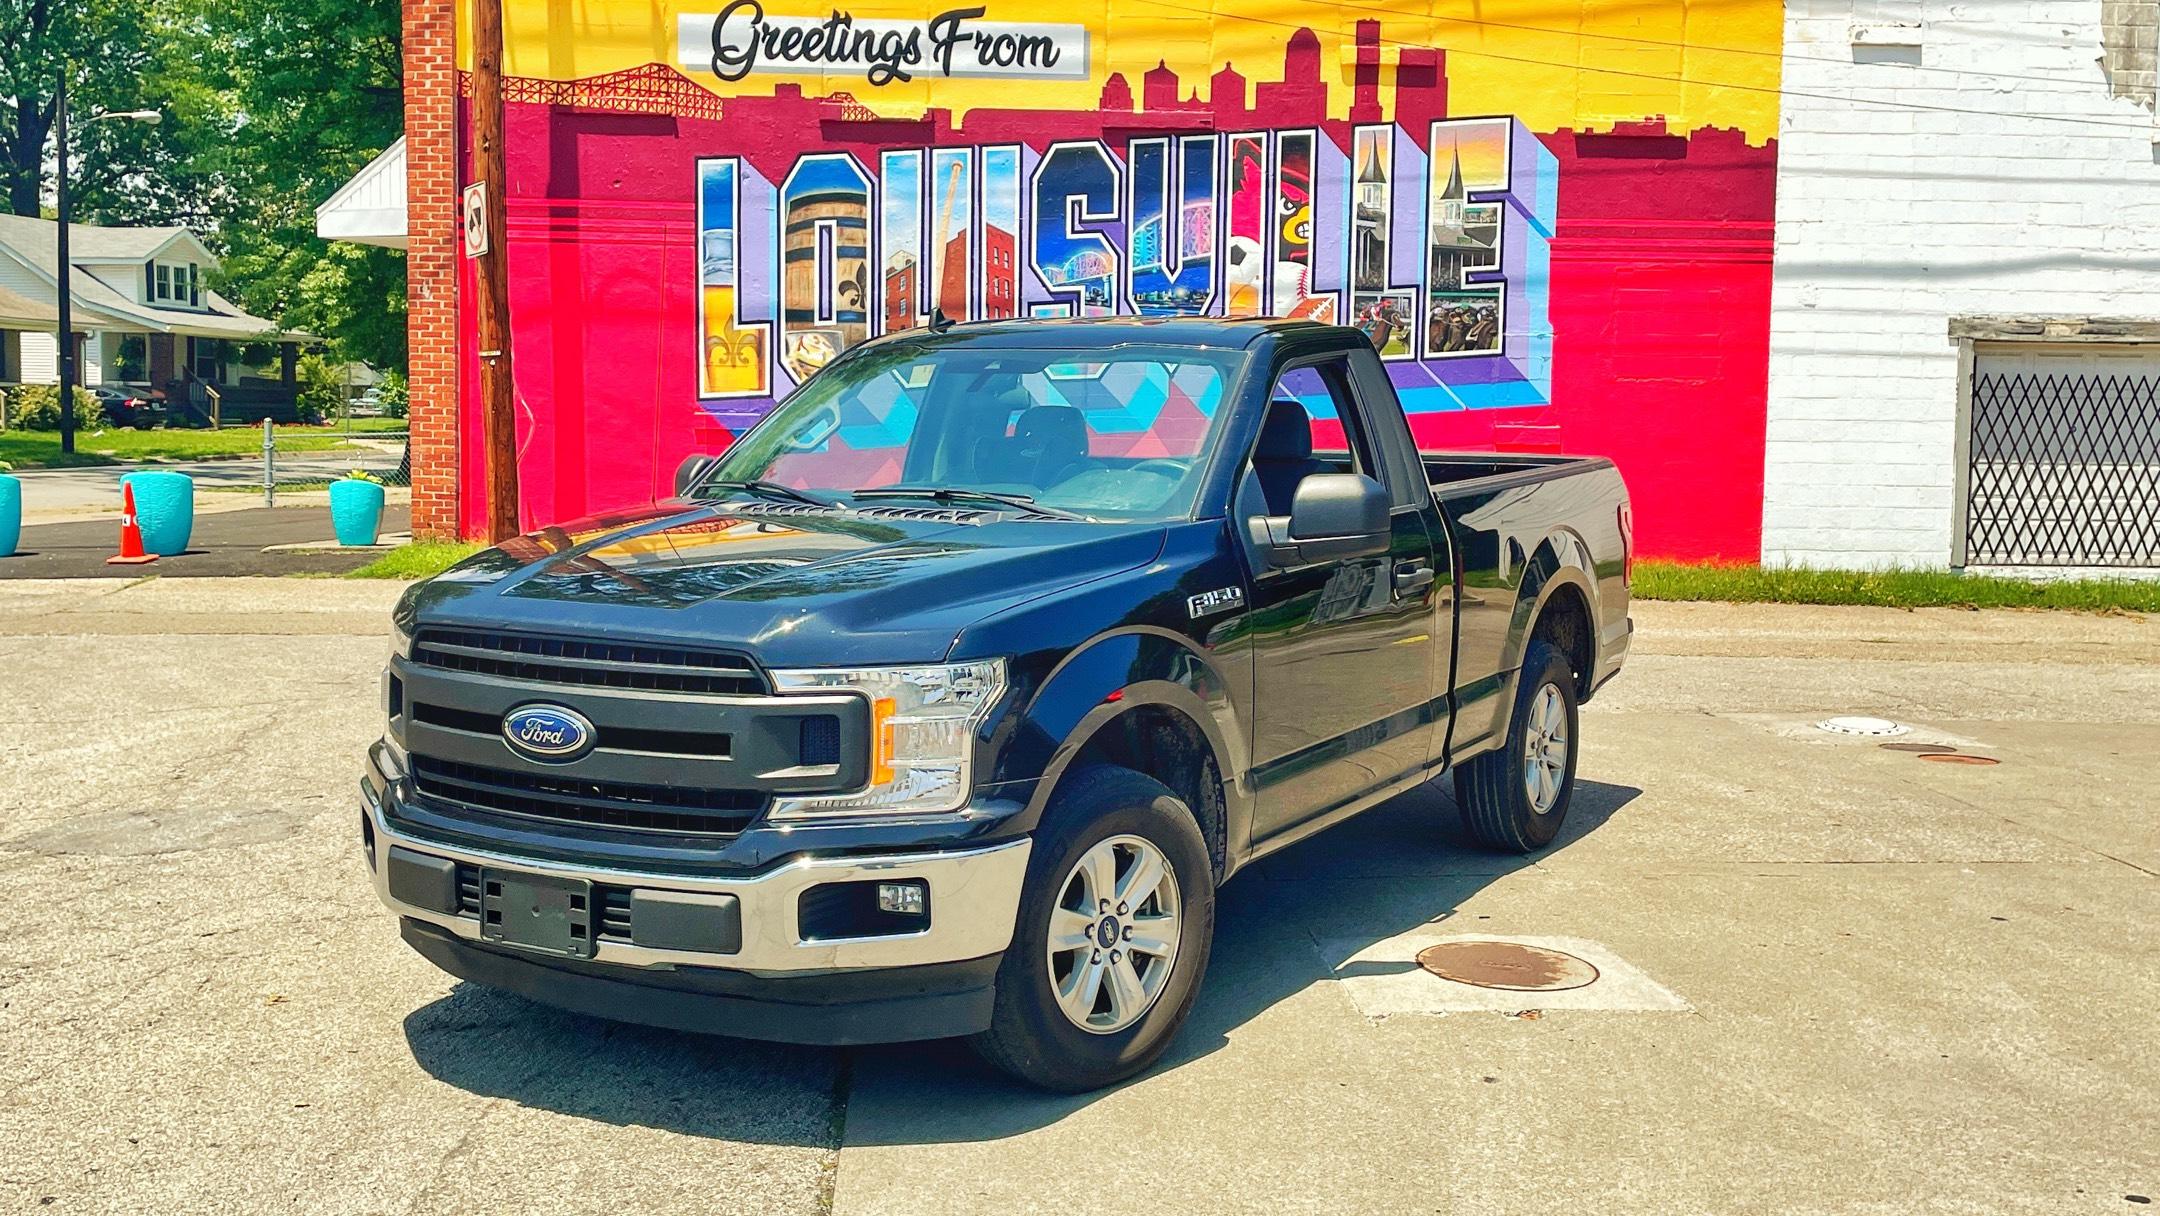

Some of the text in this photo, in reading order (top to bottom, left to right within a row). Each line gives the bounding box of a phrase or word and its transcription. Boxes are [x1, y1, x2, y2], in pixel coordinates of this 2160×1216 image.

[711, 0, 1060, 86] Greetings From
[695, 114, 1514, 401] LOUISVILLE
[520, 717, 566, 745] Ford
